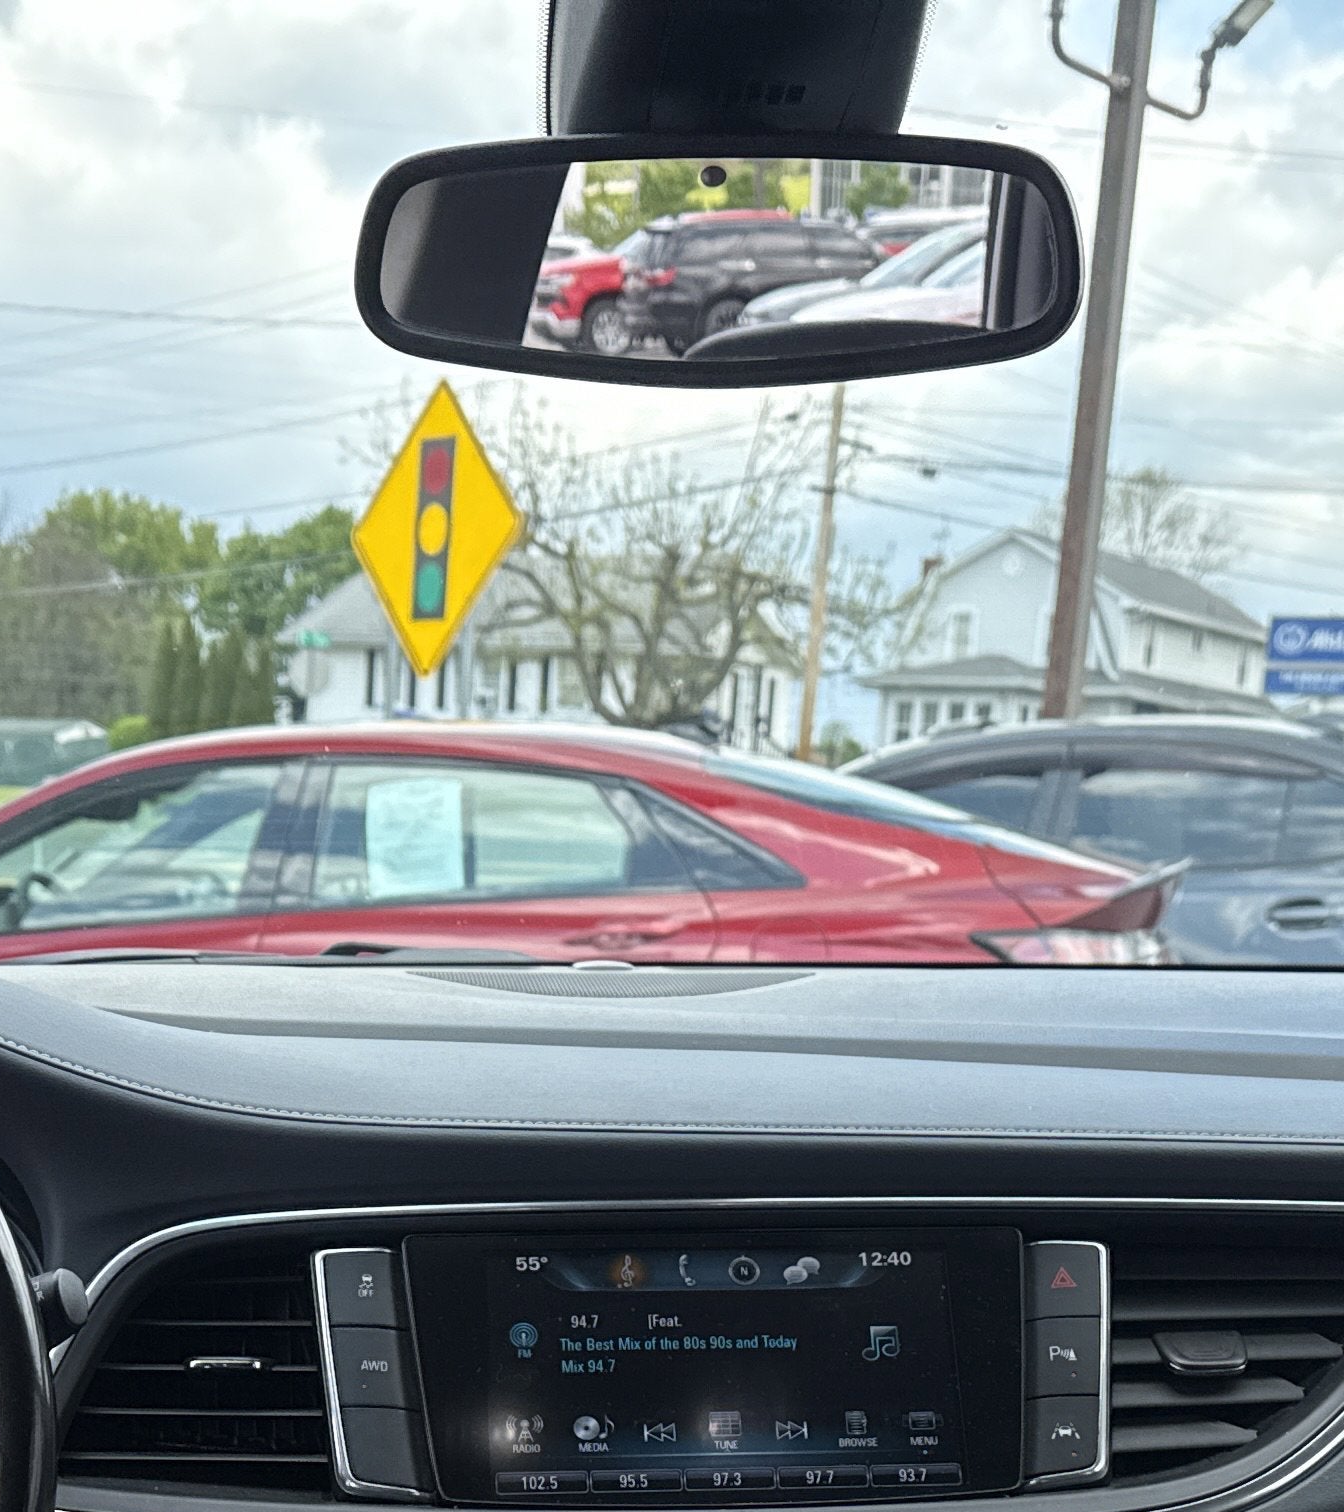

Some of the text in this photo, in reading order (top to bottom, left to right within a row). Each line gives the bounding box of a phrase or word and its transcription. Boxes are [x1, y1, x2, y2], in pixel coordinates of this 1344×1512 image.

[858, 1251, 912, 1267] 12:40
[571, 1314, 599, 1329] 94.7
[560, 1335, 798, 1352] The Best Mix of the 80s 90s and Today
[360, 1359, 389, 1372] AWD
[561, 1359, 616, 1374] Mix 94.7
[512, 1443, 541, 1454] RADIO
[578, 1442, 610, 1454] MEDIA
[714, 1439, 739, 1451] TUNE
[839, 1437, 878, 1448] BROWSE
[910, 1435, 939, 1447] MENU
[520, 1475, 558, 1490] 102.5
[619, 1473, 649, 1488] 95.5
[713, 1472, 743, 1487] 97.3
[806, 1469, 835, 1485] 97.7
[899, 1468, 928, 1483] 93.7
